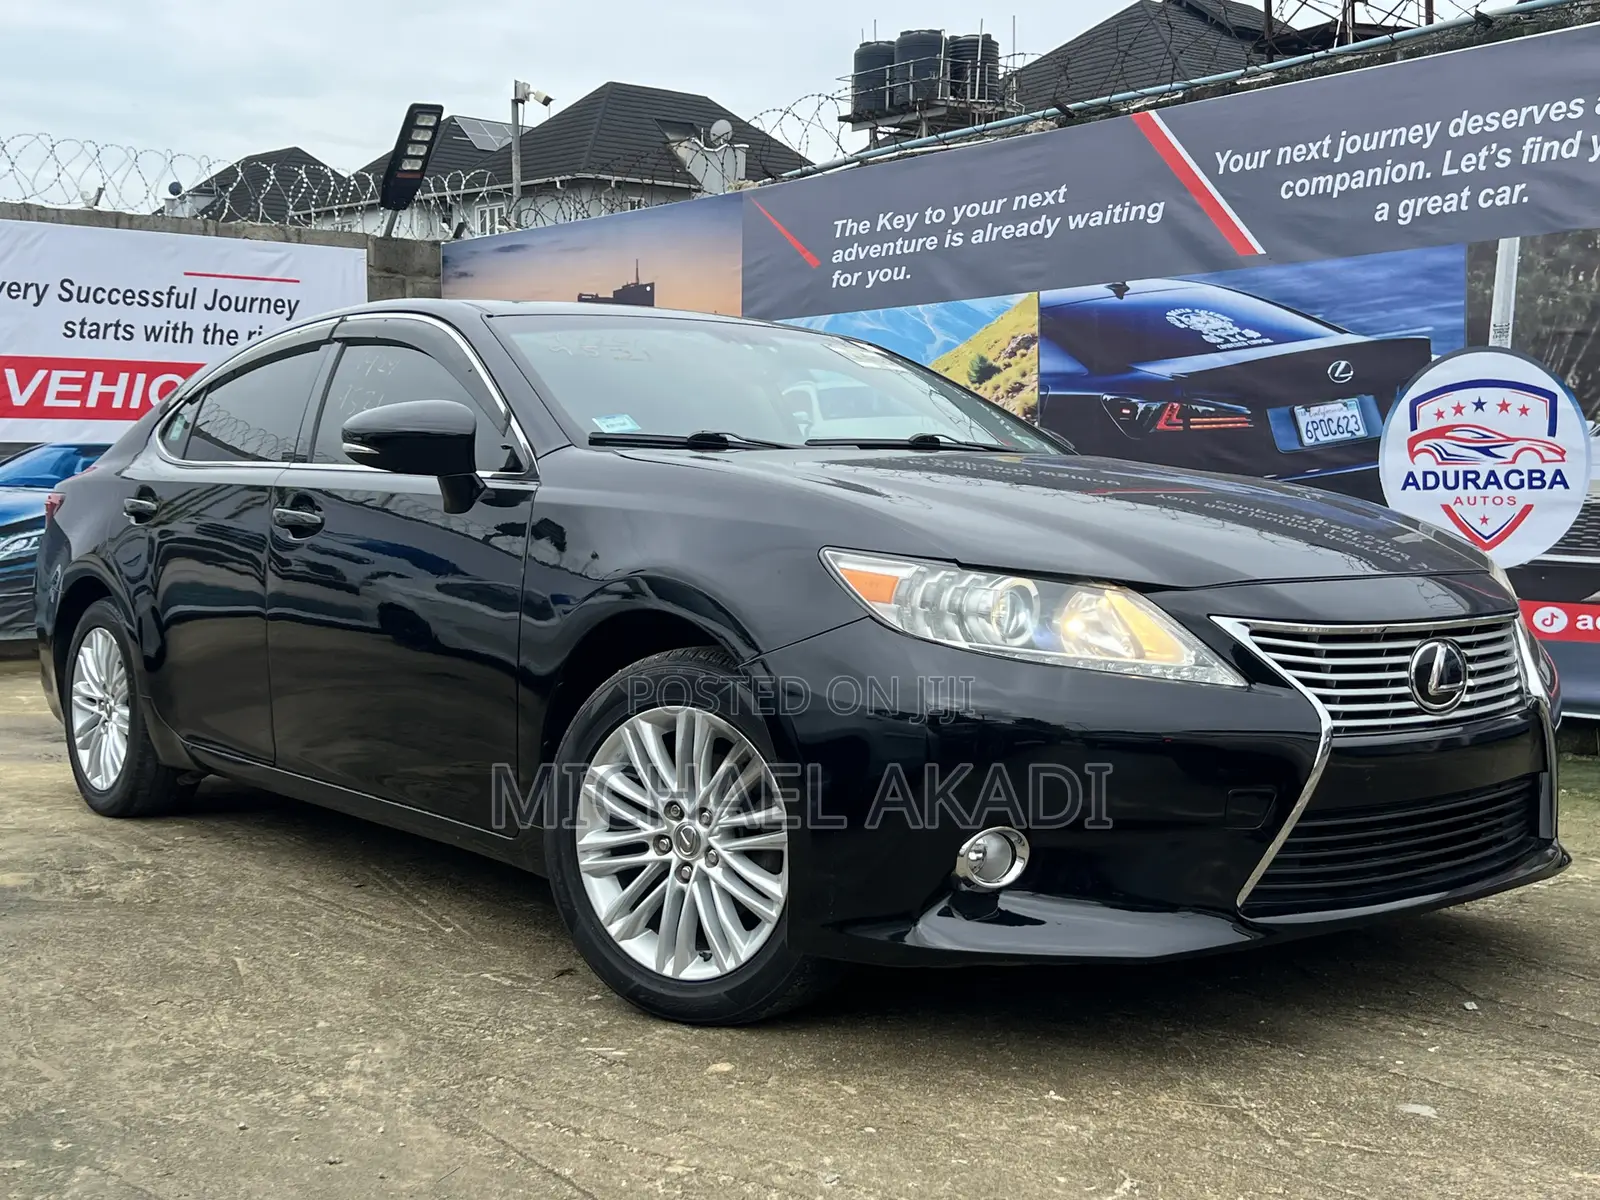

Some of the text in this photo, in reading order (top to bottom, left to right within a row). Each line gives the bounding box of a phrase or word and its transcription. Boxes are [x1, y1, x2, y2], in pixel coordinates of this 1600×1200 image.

[1215, 150, 1271, 175] Your
[1276, 134, 1332, 165] next
[1333, 120, 1441, 163] journey
[1448, 96, 1584, 138] deserves
[1280, 160, 1432, 200] companion.
[1442, 141, 1512, 177] Let's
[1521, 131, 1583, 165] find
[833, 183, 1068, 239] The Key to your next
[1374, 182, 1529, 225] a great car.
[831, 200, 1166, 264] adventure is already waiting
[831, 263, 912, 289] for you.
[57, 278, 197, 311] Successful
[204, 287, 300, 321] Journey
[62, 316, 135, 343] starts
[144, 319, 193, 345] with
[203, 321, 240, 347] the
[1401, 468, 1570, 492] ADURAGBA
[1453, 495, 1517, 507] AUTOS
[1576, 614, 1600, 631] a
